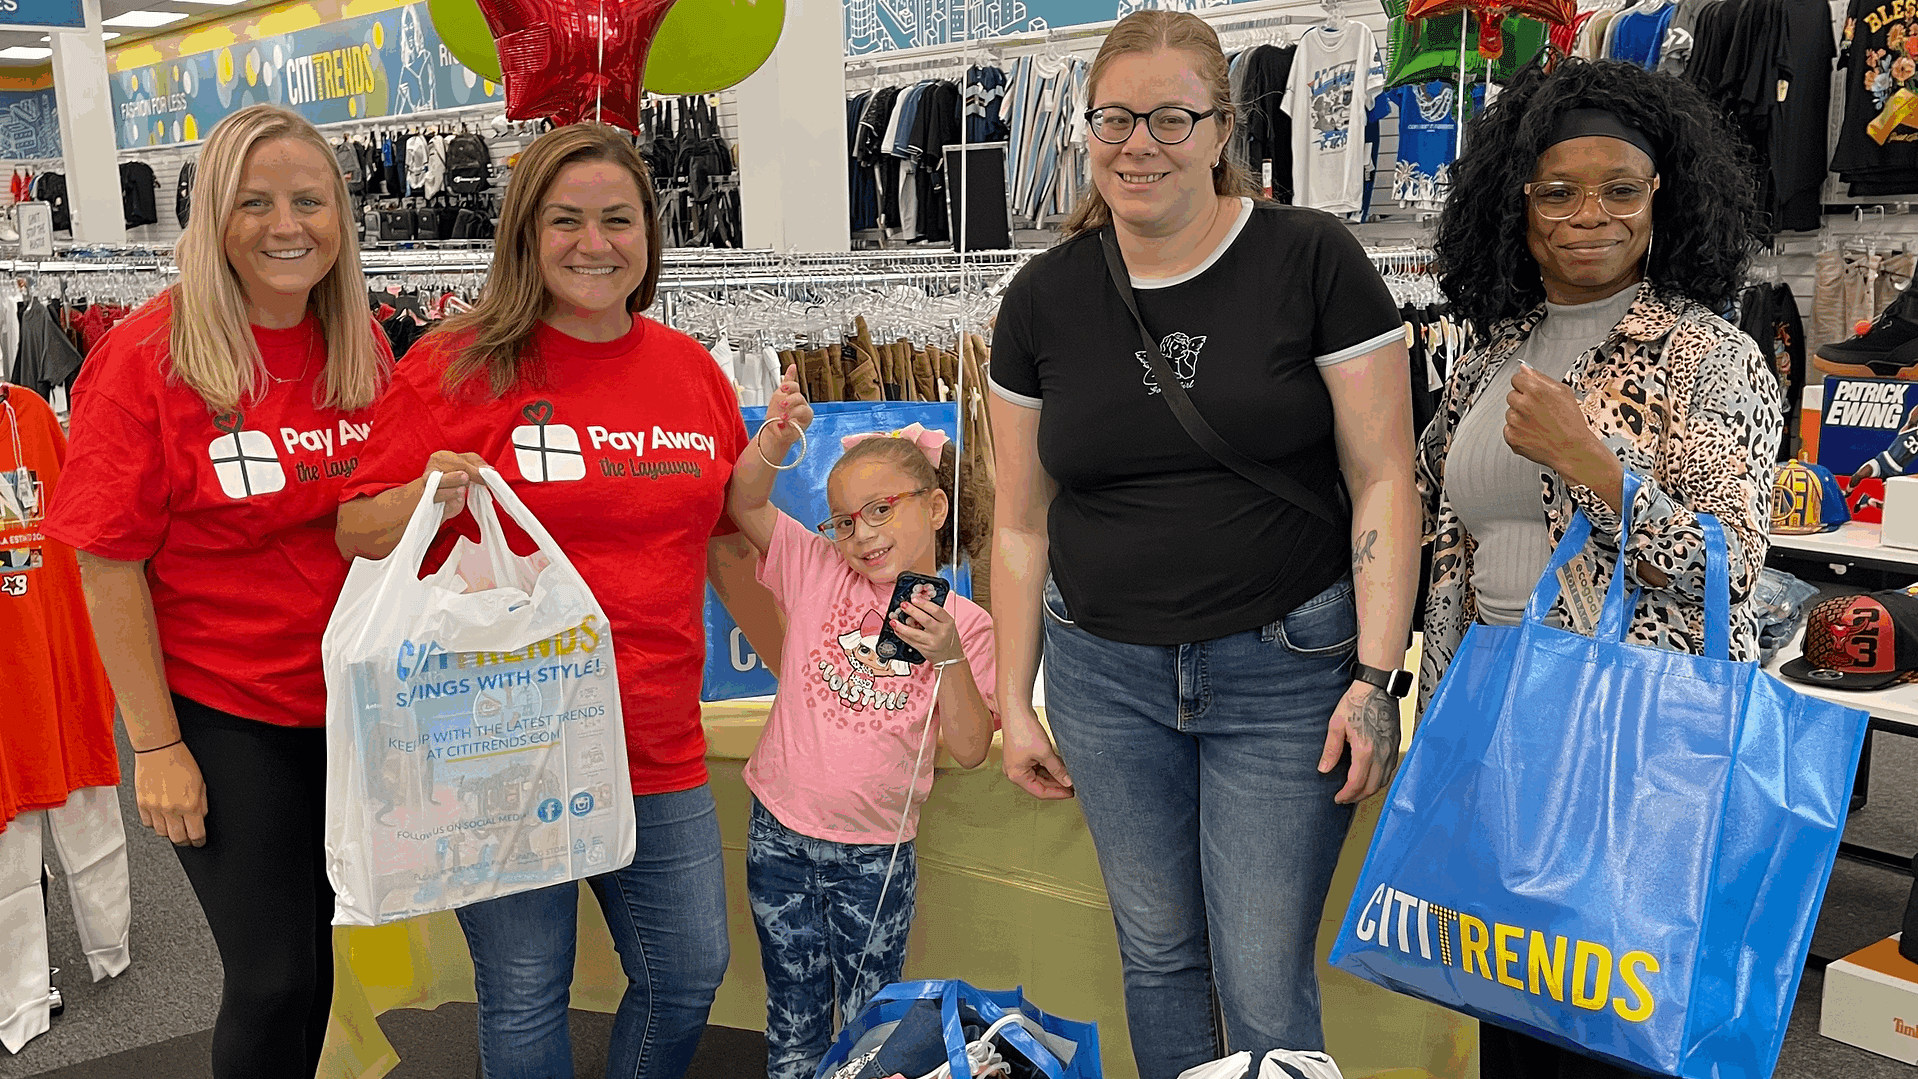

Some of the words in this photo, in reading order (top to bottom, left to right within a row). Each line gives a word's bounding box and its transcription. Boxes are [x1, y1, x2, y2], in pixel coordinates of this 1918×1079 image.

[1863, 0, 1918, 33] BLES
[286, 43, 375, 106] CITITRENDS
[120, 101, 152, 119] FASHION
[151, 95, 168, 115] FOR
[168, 92, 188, 112] LESS
[1834, 381, 1909, 404] PATRICK
[1825, 401, 1903, 429] EWING
[280, 427, 333, 457] Pay
[338, 419, 373, 446] Aw
[587, 425, 645, 457] Pay
[652, 425, 715, 460] Away
[296, 460, 320, 482] the
[600, 457, 626, 477] the
[628, 458, 701, 480] Layaway
[477, 670, 531, 691] WITH
[537, 658, 600, 683] STYLE!
[433, 727, 472, 743] WITH
[476, 722, 503, 737] THE
[506, 715, 553, 734] LATEST
[556, 706, 605, 723] TRENDS
[426, 747, 443, 761] AT
[433, 826, 445, 835] US
[446, 823, 461, 832] ON
[464, 817, 497, 830] SOCIAL
[1356, 882, 1660, 1023] CITITRENDS
[1893, 1017, 1918, 1039] Tim
